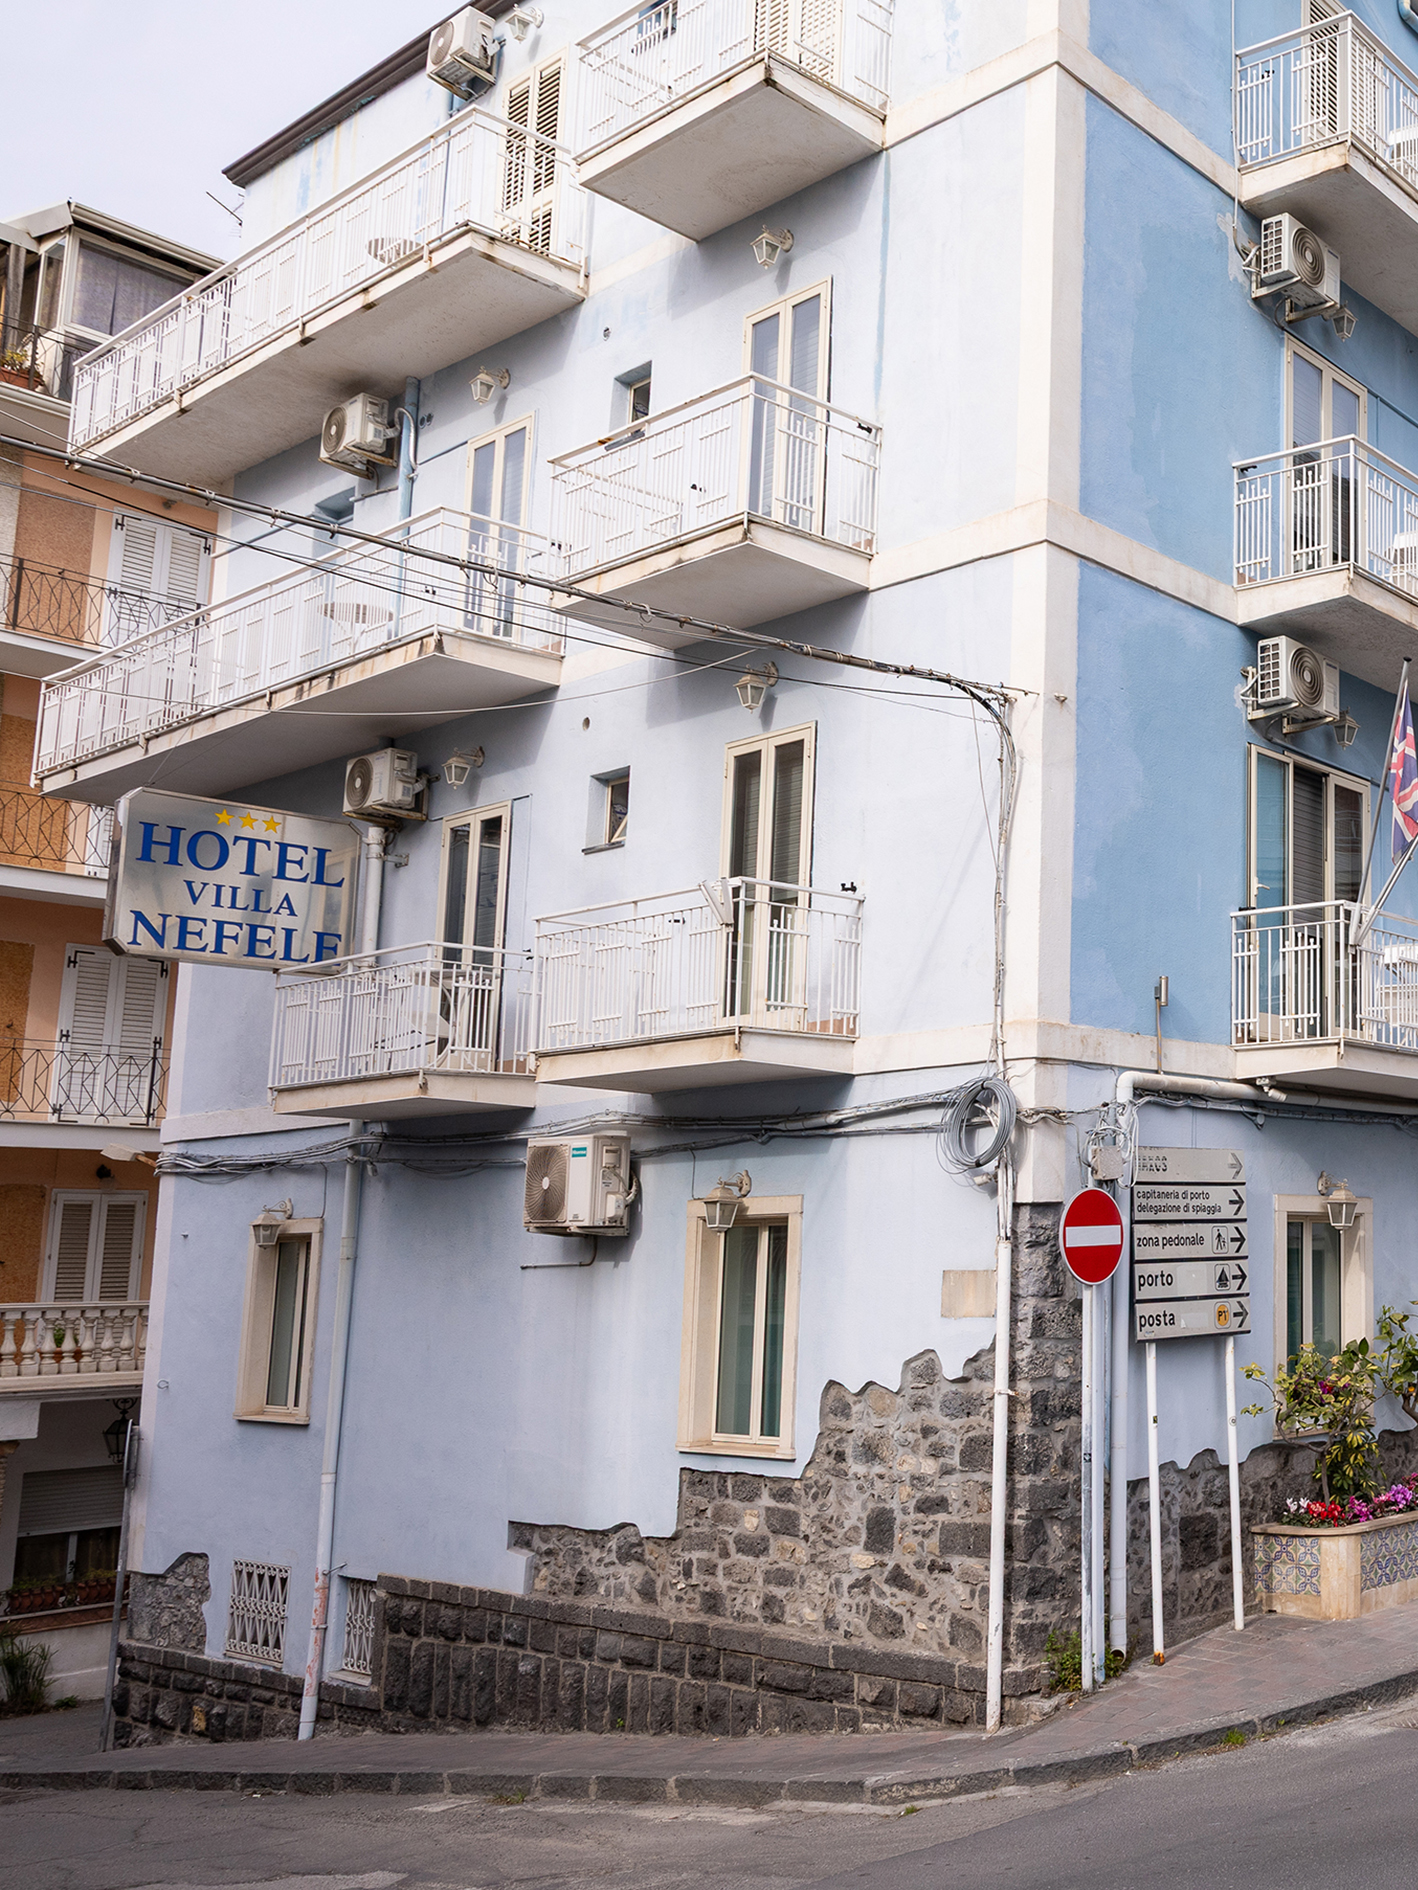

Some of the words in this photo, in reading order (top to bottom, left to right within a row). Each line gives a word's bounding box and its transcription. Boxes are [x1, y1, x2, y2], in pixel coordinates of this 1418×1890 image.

[135, 821, 345, 888] HOTEL
[183, 879, 299, 917] VILLA
[127, 909, 342, 966] NEFELE
[1136, 1189, 1180, 1201] capitaneria
[1181, 1190, 1189, 1200] di
[1190, 1190, 1210, 1201] porto
[1136, 1202, 1181, 1215] delegazione
[1183, 1203, 1190, 1213] di
[1191, 1203, 1222, 1215] spiaggia
[1136, 1236, 1160, 1247] zona
[1162, 1232, 1205, 1250] pedonale
[1138, 1270, 1173, 1291] porto
[1139, 1310, 1175, 1332] posta
